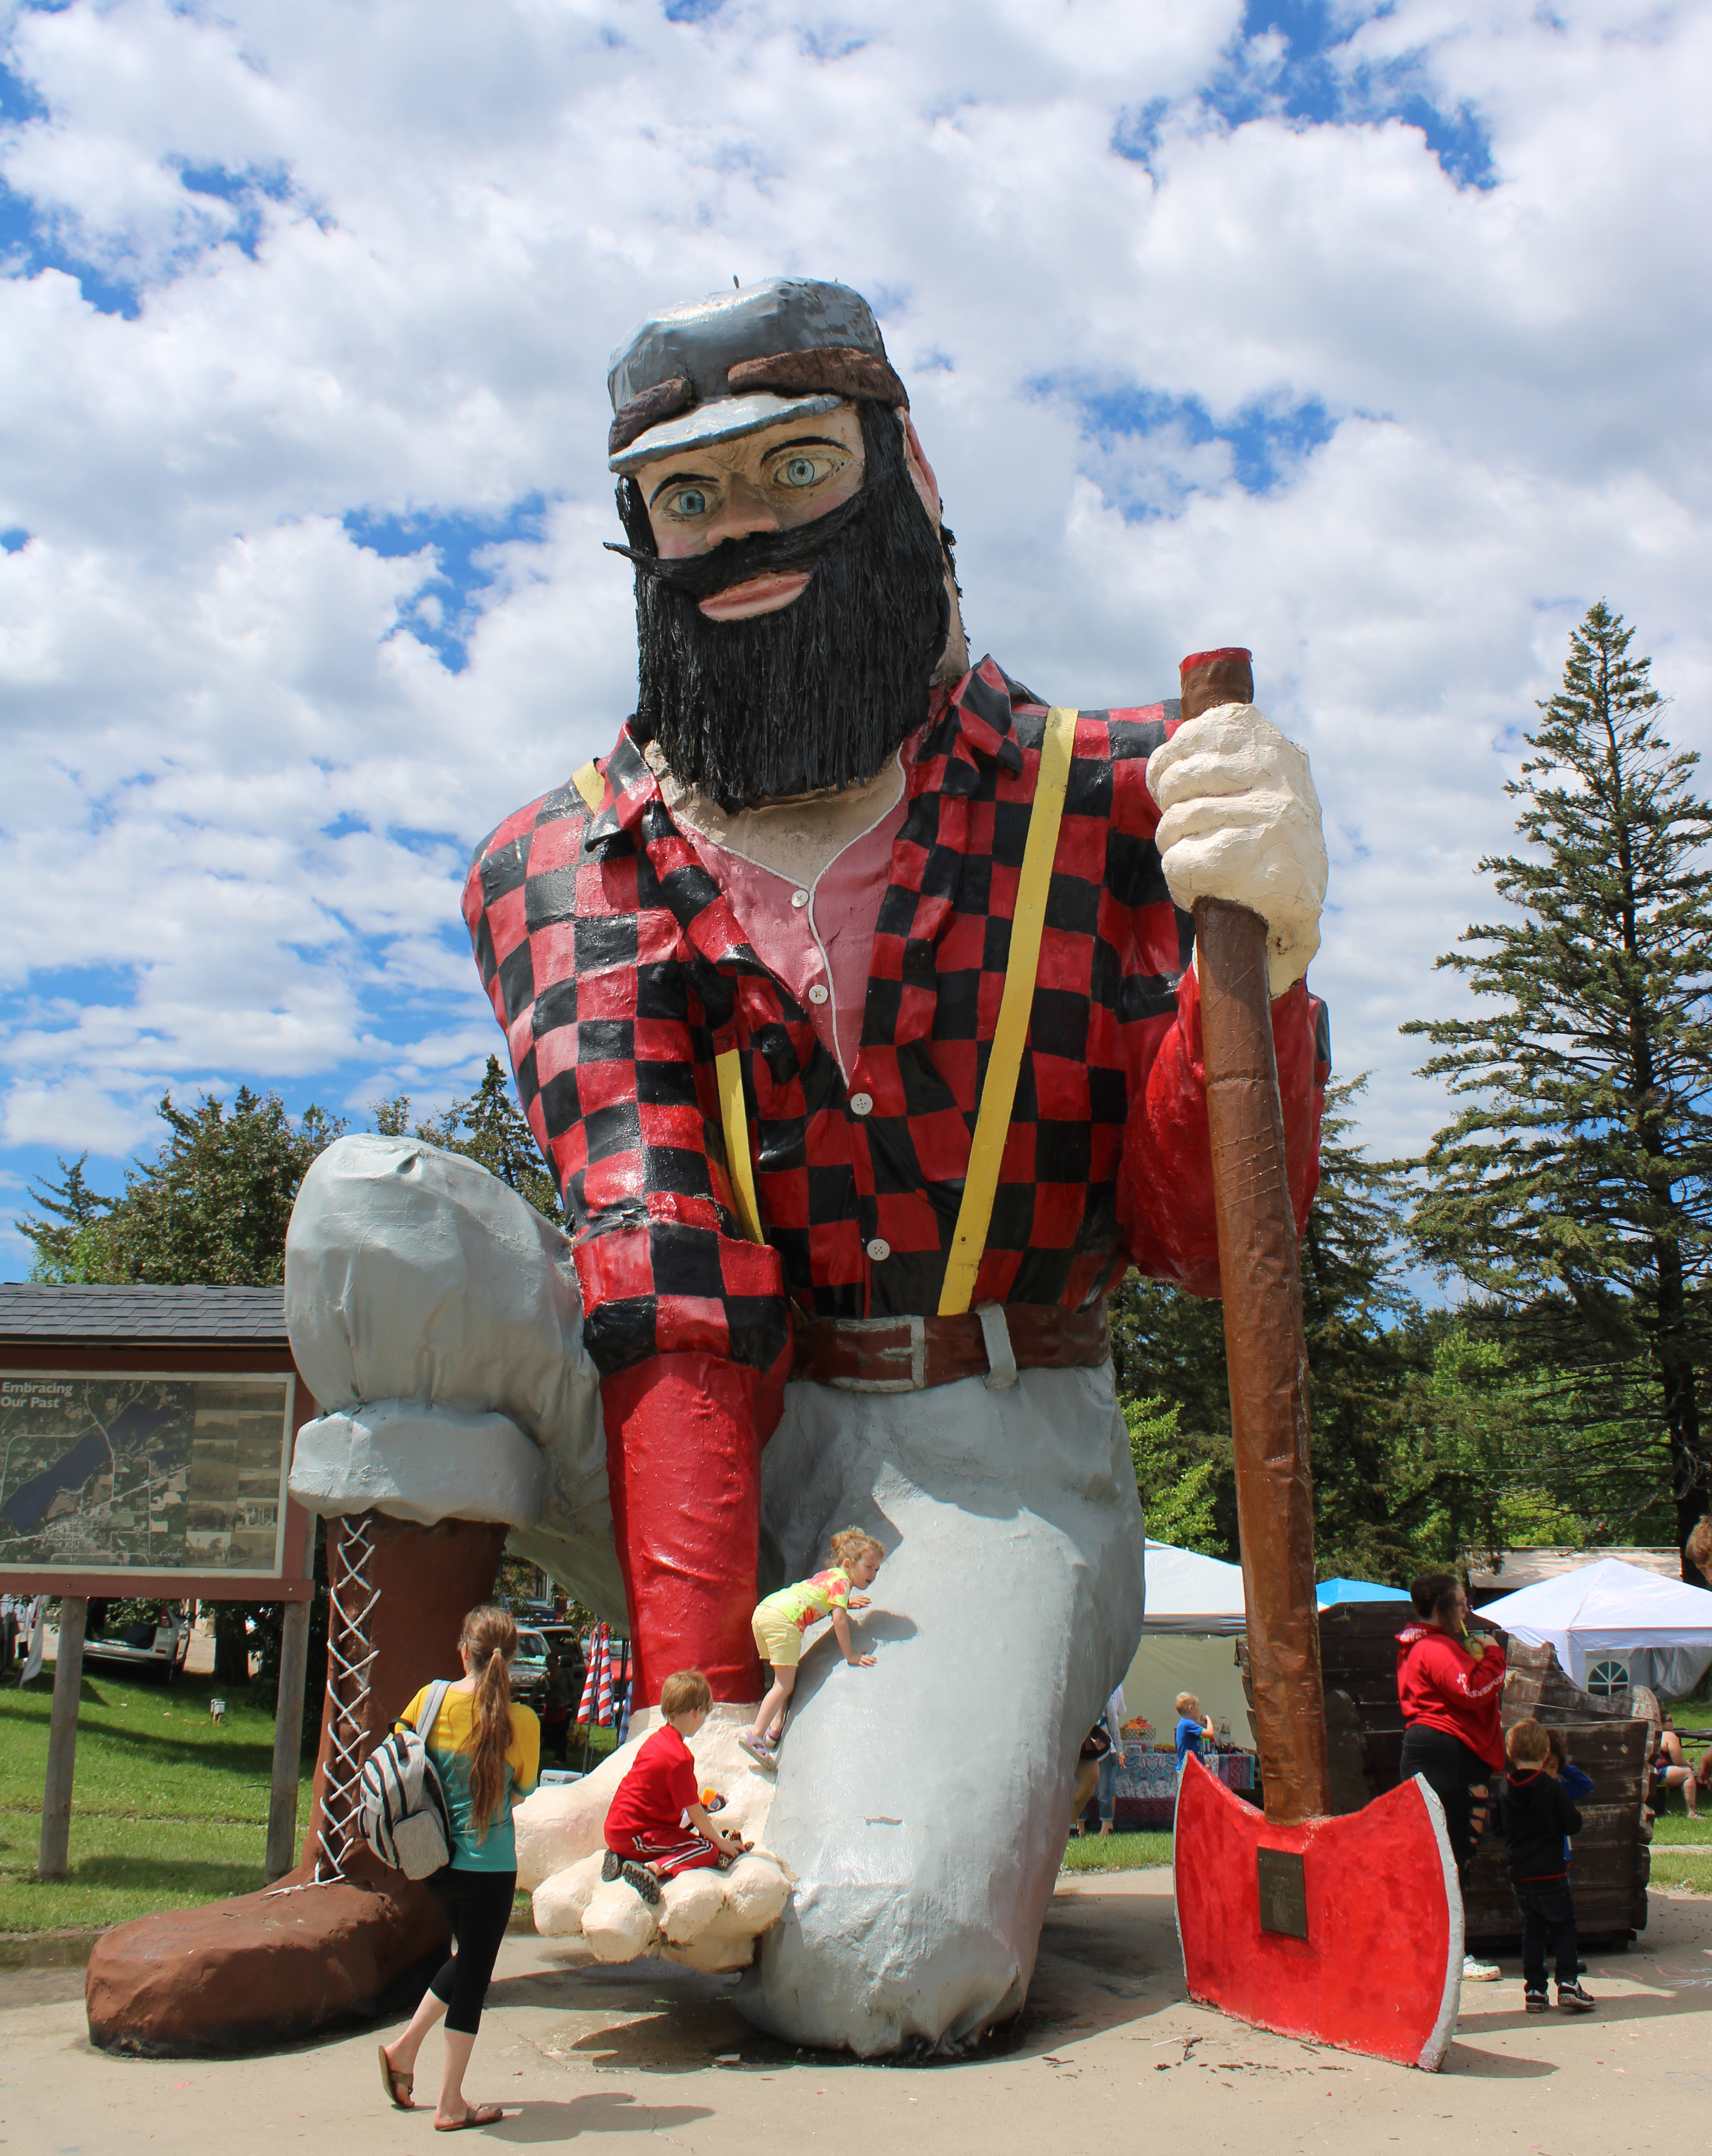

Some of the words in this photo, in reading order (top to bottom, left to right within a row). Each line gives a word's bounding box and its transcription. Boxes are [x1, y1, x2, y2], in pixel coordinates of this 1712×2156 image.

[2, 1382, 73, 1397] Embracing
[0, 1396, 27, 1407] Our
[30, 1397, 59, 1408] Past
